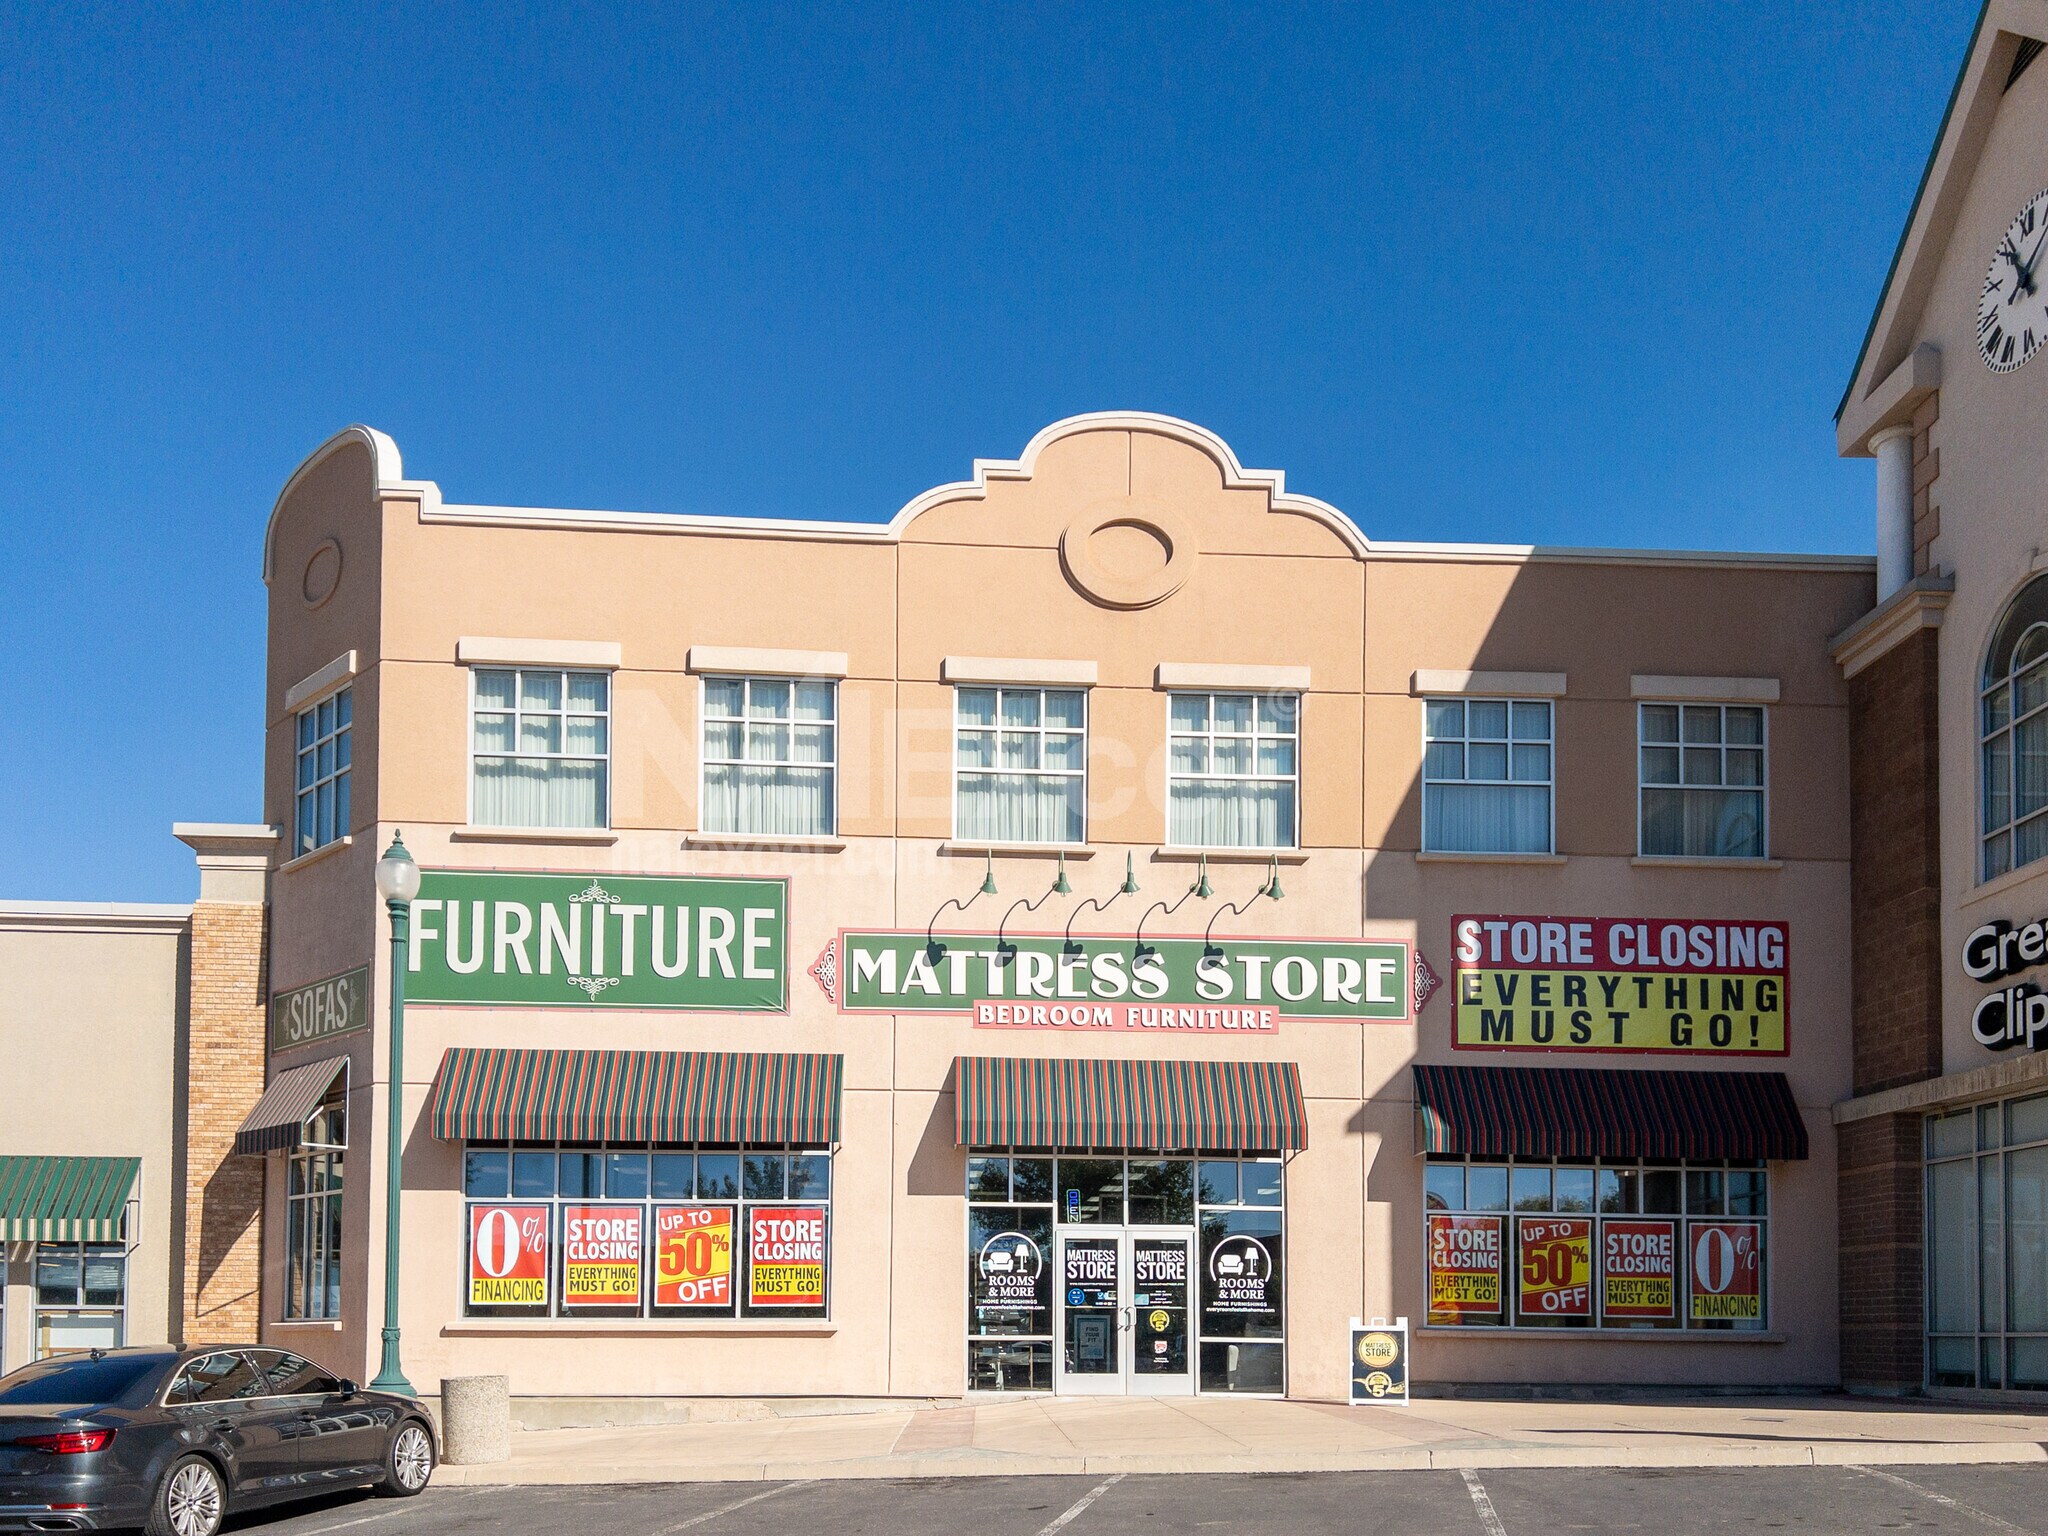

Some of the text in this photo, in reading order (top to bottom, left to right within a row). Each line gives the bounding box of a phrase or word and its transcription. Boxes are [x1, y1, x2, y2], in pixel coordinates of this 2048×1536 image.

[408, 898, 776, 979] FURNITURE
[1456, 919, 1785, 969] STORE CLOSING
[1961, 923, 2048, 979] Gre
[851, 947, 1396, 1004] MATTRESS STORE
[1462, 972, 1779, 1013] EVERYTHING
[289, 978, 349, 1041] SOFAS
[978, 1005, 1273, 1029] BEDROOM FURNITURE
[1480, 1008, 1761, 1048] MUST GO!
[1069, 1191, 1079, 1222] OPEN
[569, 1218, 638, 1242] STORE
[660, 1210, 713, 1231] UP TO
[754, 1219, 822, 1242] STORE
[1433, 1228, 1498, 1252] STORE
[1523, 1223, 1572, 1242] UP TO
[476, 1209, 544, 1277] 0%
[569, 1241, 638, 1260] CLOSING
[754, 1241, 822, 1261] CLOSING
[1606, 1234, 1671, 1256] STORE
[659, 1231, 729, 1276] 50%
[1067, 1249, 1115, 1261] MATTRESS
[1136, 1250, 1185, 1262] MATTRESS
[1432, 1251, 1498, 1269] CLOSING
[1695, 1228, 1757, 1294] 0%
[569, 1266, 636, 1281] EVERYTHING
[754, 1267, 821, 1281] EVERYTHING
[1067, 1261, 1116, 1279] STORE
[1137, 1262, 1186, 1280] STORE
[1522, 1243, 1588, 1287] 50%
[1606, 1255, 1671, 1274] CLOSING
[473, 1279, 544, 1301] FINANCING
[569, 1279, 636, 1292] MUST GO!
[678, 1276, 728, 1302] OFF
[754, 1279, 820, 1293] MUST GO!
[988, 1276, 1035, 1286] ROOMS
[1218, 1278, 1265, 1289] ROOMS
[1433, 1275, 1497, 1289] EVERYTHING
[1607, 1280, 1670, 1293] EVERYTHING
[988, 1287, 1035, 1296] & MORE
[1218, 1290, 1265, 1299] & MORE
[1433, 1287, 1496, 1301] MUST GO!
[1541, 1287, 1587, 1311] OFF
[1607, 1292, 1669, 1305] MUST GO!
[1692, 1295, 1758, 1317] FINANCING
[1365, 1348, 1391, 1357] STORE
